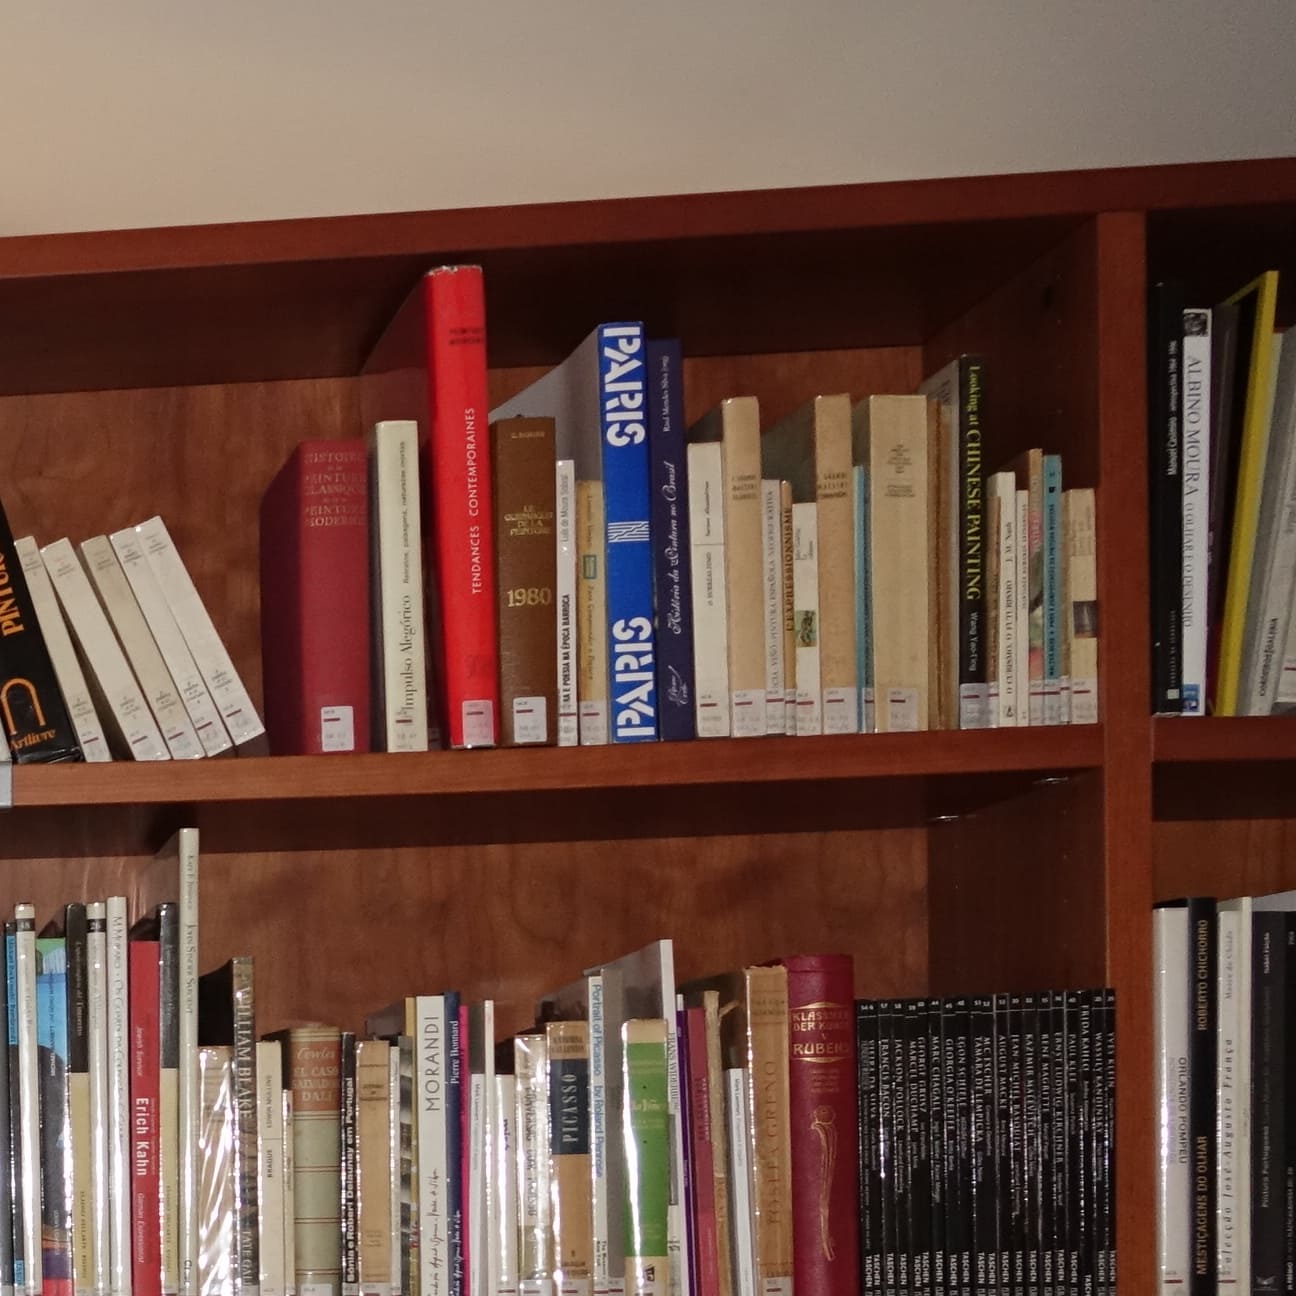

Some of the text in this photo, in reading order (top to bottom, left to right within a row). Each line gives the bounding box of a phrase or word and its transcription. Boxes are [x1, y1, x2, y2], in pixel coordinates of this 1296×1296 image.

[604, 326, 644, 446] PARIS
[1185, 358, 1201, 496] ALBINO MOURA
[465, 407, 482, 595] TENDANCES CONTEMPORAINES
[966, 429, 981, 600] CHINESE PAINTING
[507, 587, 552, 607] 1980
[561, 594, 570, 627] BARROCA
[612, 616, 655, 738] PARIS
[1198, 920, 1208, 1030] ROBERTO CHICHORRO
[237, 985, 252, 1120] WILLIAM BLAKE
[424, 1016, 440, 1111] MORANDI
[449, 1021, 460, 1084] Pierre Bonnard
[591, 984, 604, 1134] Portrait of Picasso by Roland
[881, 1040, 890, 1117] FRANCIS BACON
[895, 1040, 904, 1130] JACKSON POLLOCK
[910, 1041, 918, 1132] MARCEL DUCHAMP
[918, 1037, 927, 1112] GEORGE GROSZ
[932, 1036, 940, 1111] MARC CHAGALL
[945, 1039, 954, 1083] GEORGIA
[958, 1037, 966, 1106] EGON SCHIELE
[975, 1037, 983, 1141] TAMARA DE LEMPICKA
[999, 1035, 1007, 1109] AUGUST MACKE
[1024, 1034, 1034, 1076] KAZIMIR
[1041, 1063, 1050, 1111] MAGRITTE
[1081, 1038, 1089, 1071] KAHLO
[135, 1097, 150, 1176] Erich Kahn
[560, 1073, 578, 1142] PICASSO
[1055, 1067, 1063, 1163] LUDWIG KIRCHNER
[1178, 1057, 1188, 1164] ORLANDO POMPEU
[344, 1078, 357, 1239] Robert Delaunay em Portugal
[1196, 1136, 1209, 1274] MESTIÇAGENS OLHAR
[1001, 1252, 1009, 1282] TASCHEN
[1044, 1251, 1052, 1282] TASCHEN
